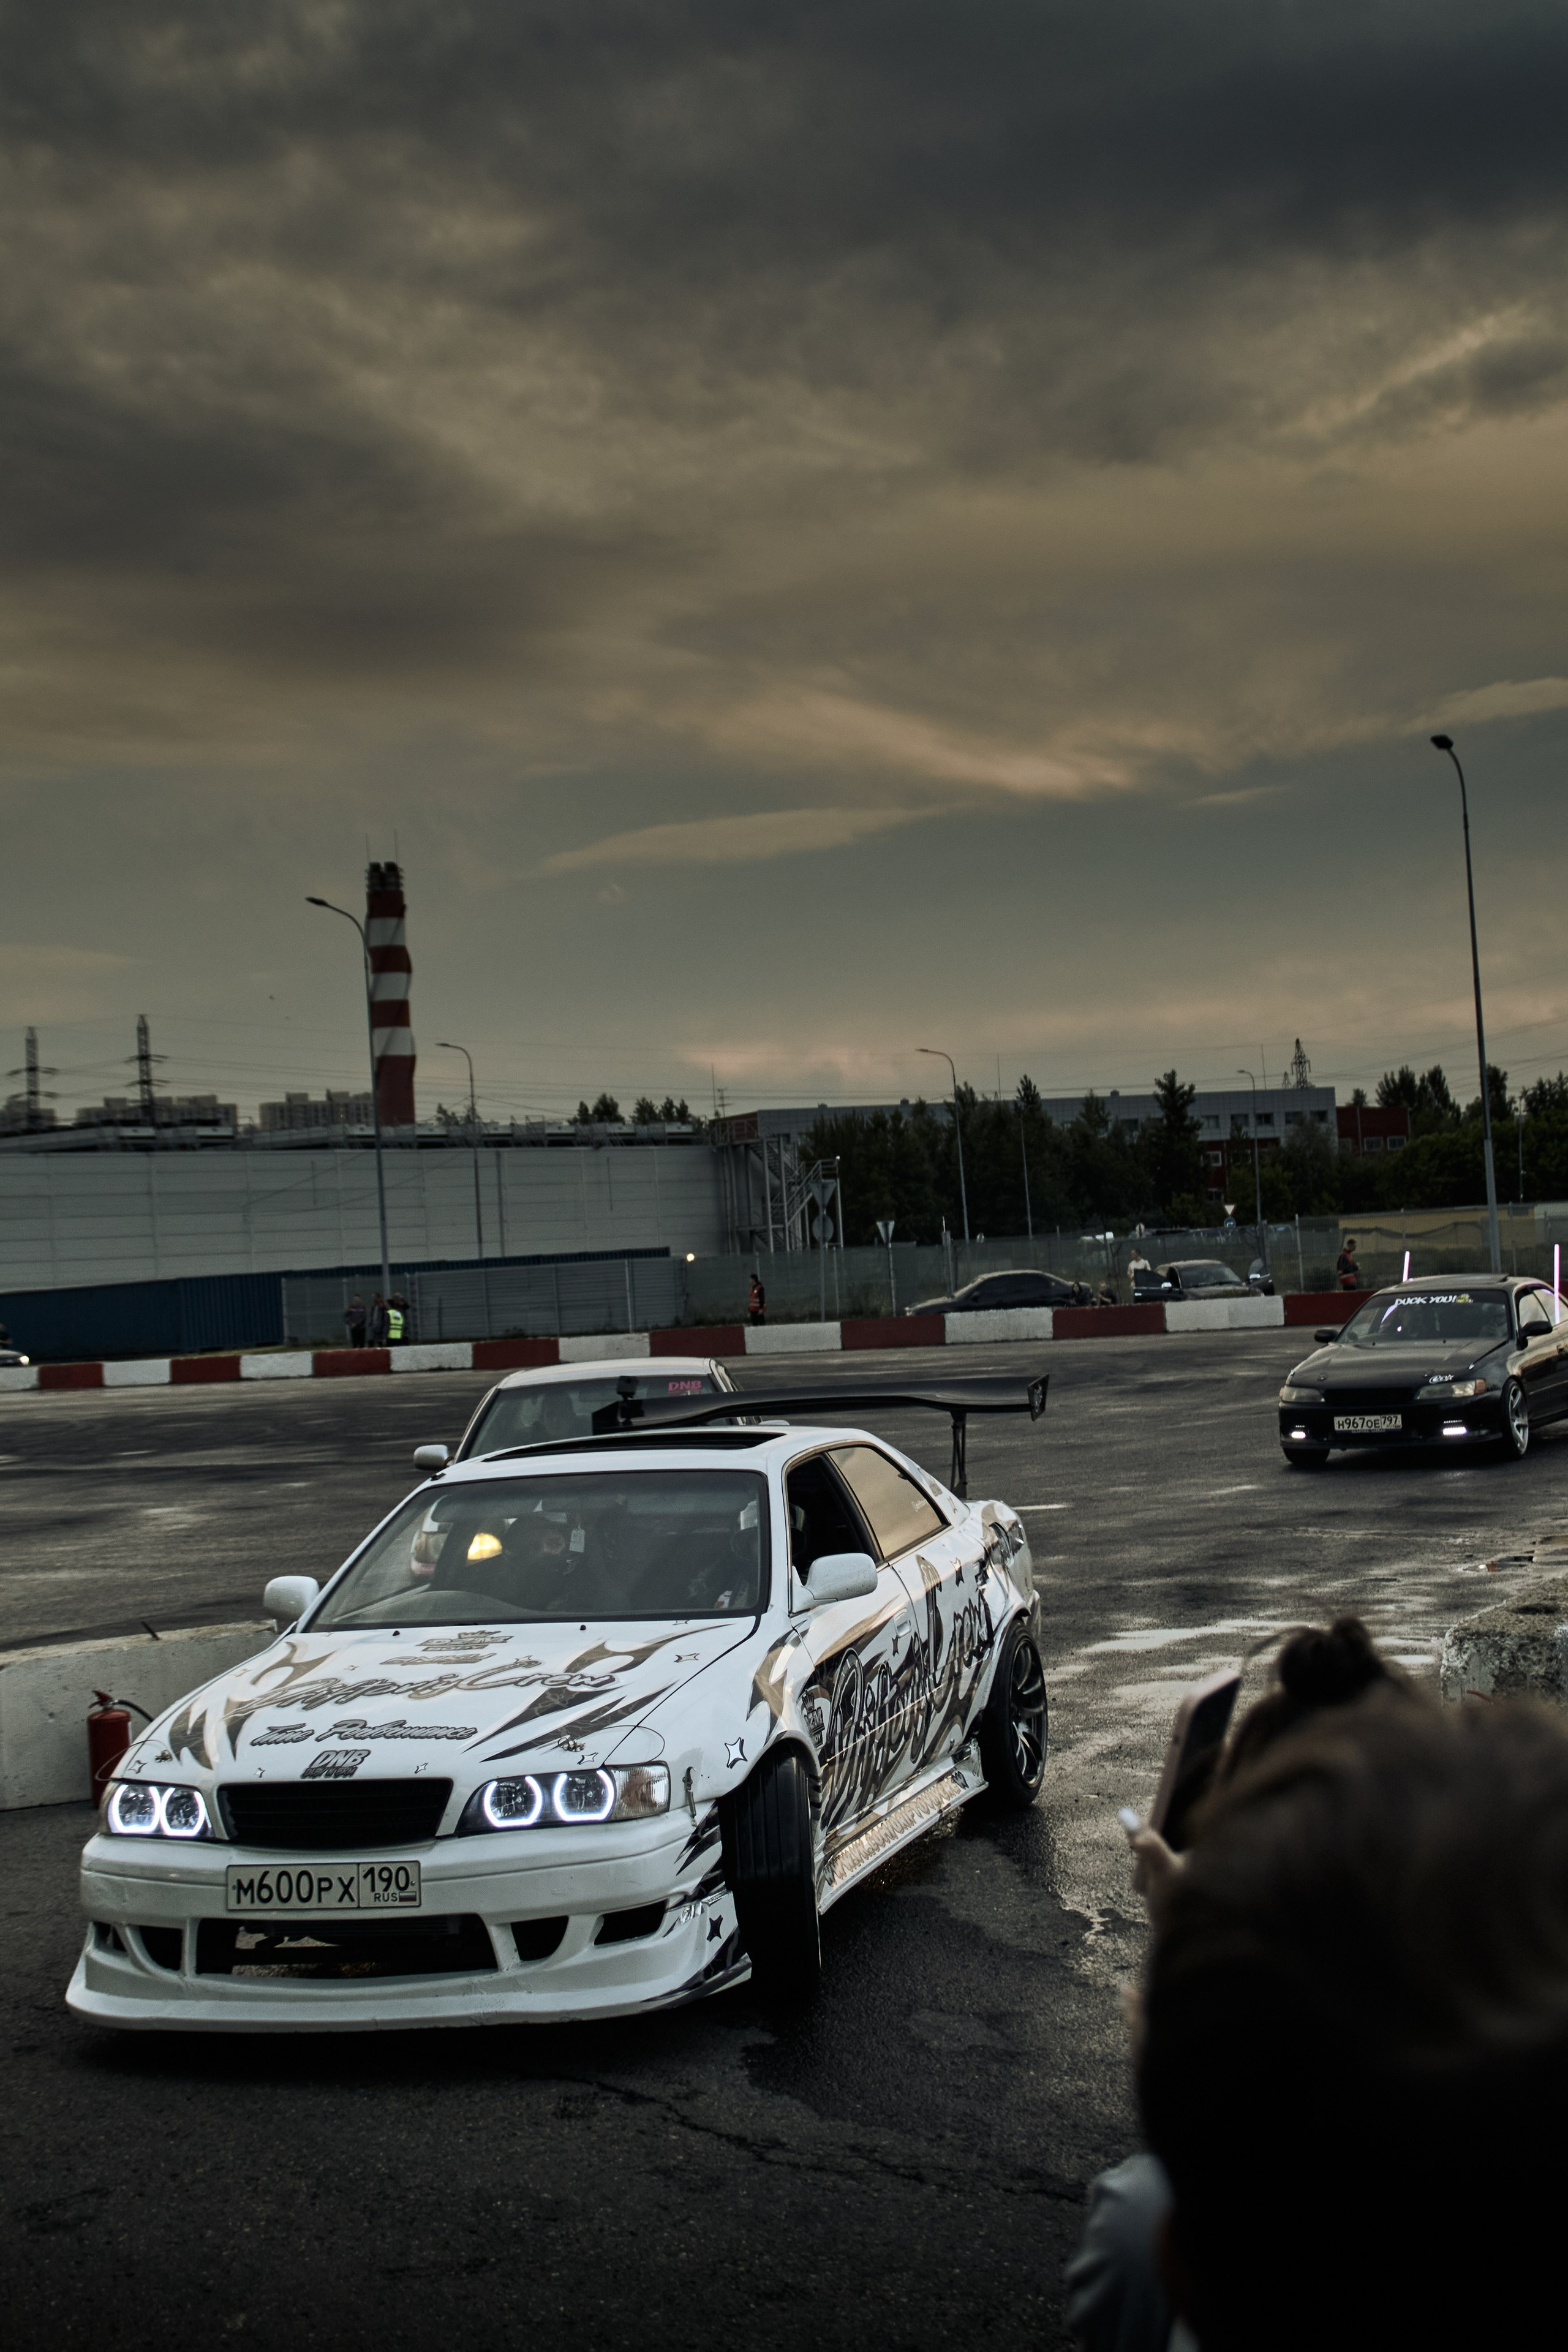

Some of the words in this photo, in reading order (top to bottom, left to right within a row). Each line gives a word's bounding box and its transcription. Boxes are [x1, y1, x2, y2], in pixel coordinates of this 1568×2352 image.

[1395, 1296, 1428, 1305] DUCK
[1429, 1295, 1457, 1304] YOU!
[668, 1380, 702, 1392] DNB
[1382, 1415, 1398, 1425] 797
[309, 1749, 371, 1768] DNB
[363, 1866, 410, 1893] 190
[374, 1892, 398, 1902] RUS
